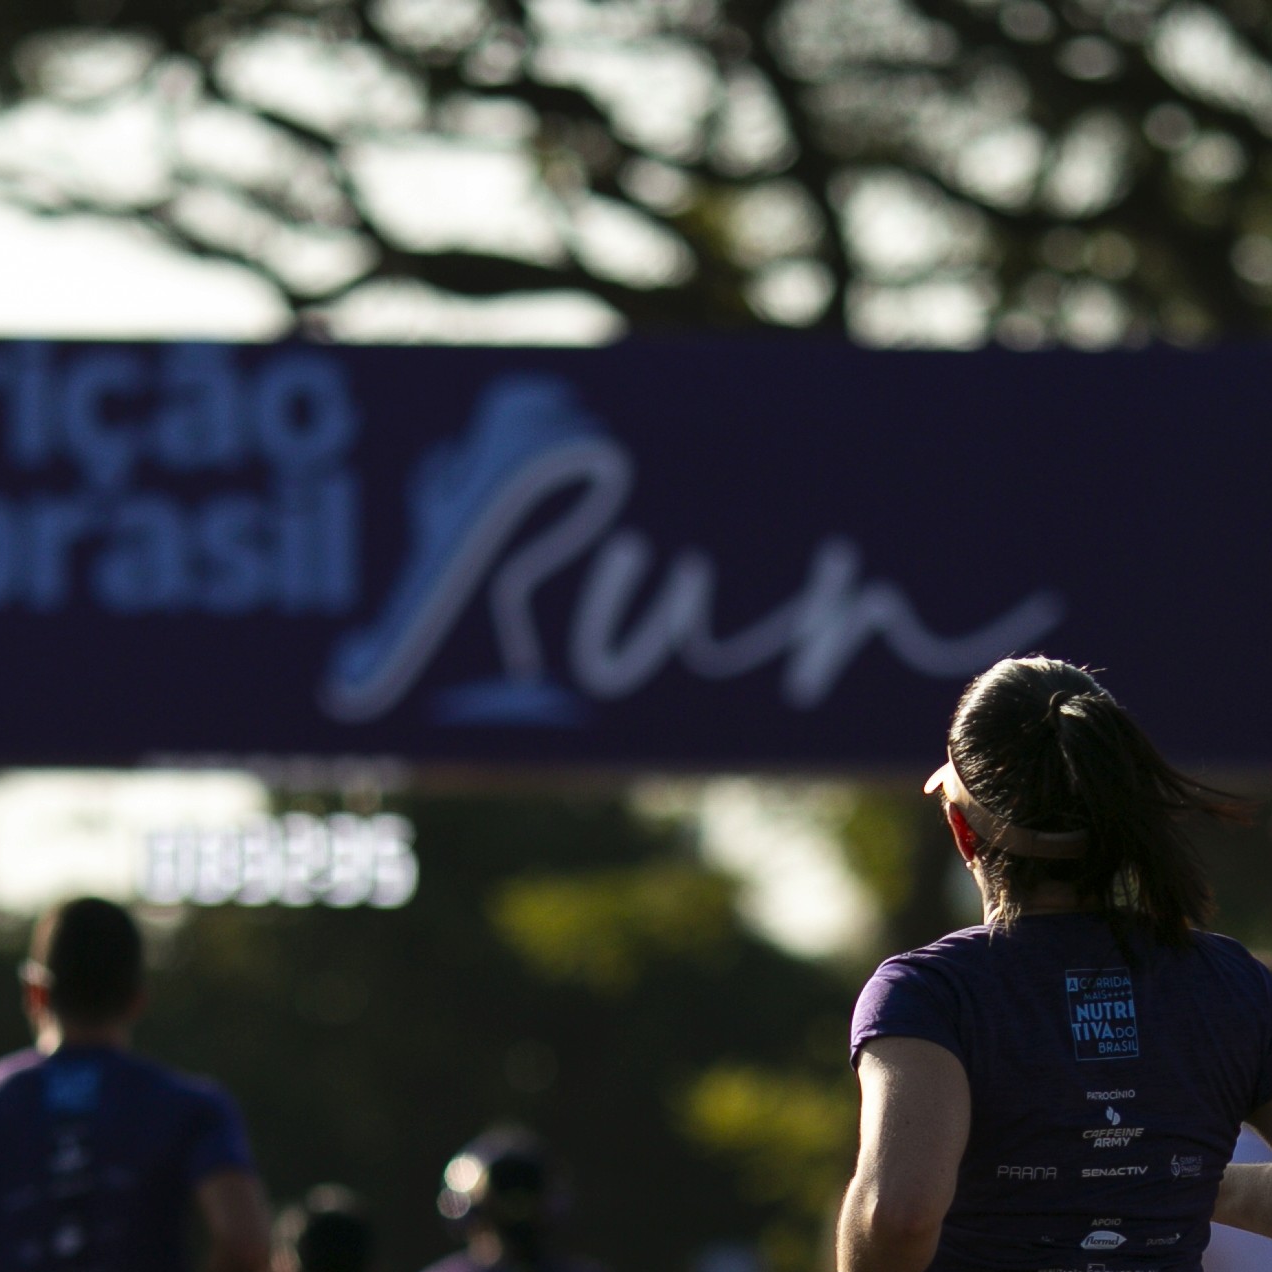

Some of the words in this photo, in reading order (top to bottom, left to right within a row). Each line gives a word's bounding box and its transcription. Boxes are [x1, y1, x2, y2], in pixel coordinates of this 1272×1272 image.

[321, 435, 1065, 722] Run
[1076, 999, 1135, 1022] NUTRI
[1072, 1021, 1115, 1041] TIVA
[1115, 1026, 1136, 1039] DO
[1098, 1040, 1138, 1054] BRASIL
[1086, 1088, 1136, 1100] PATROCÍNIO
[1082, 1127, 1145, 1139] CAFFEINE
[1093, 1137, 1131, 1149] ARMY
[997, 1165, 1058, 1180] PRANA
[1081, 1165, 1149, 1178] SENACTIV
[1090, 1218, 1122, 1227] APOIO
